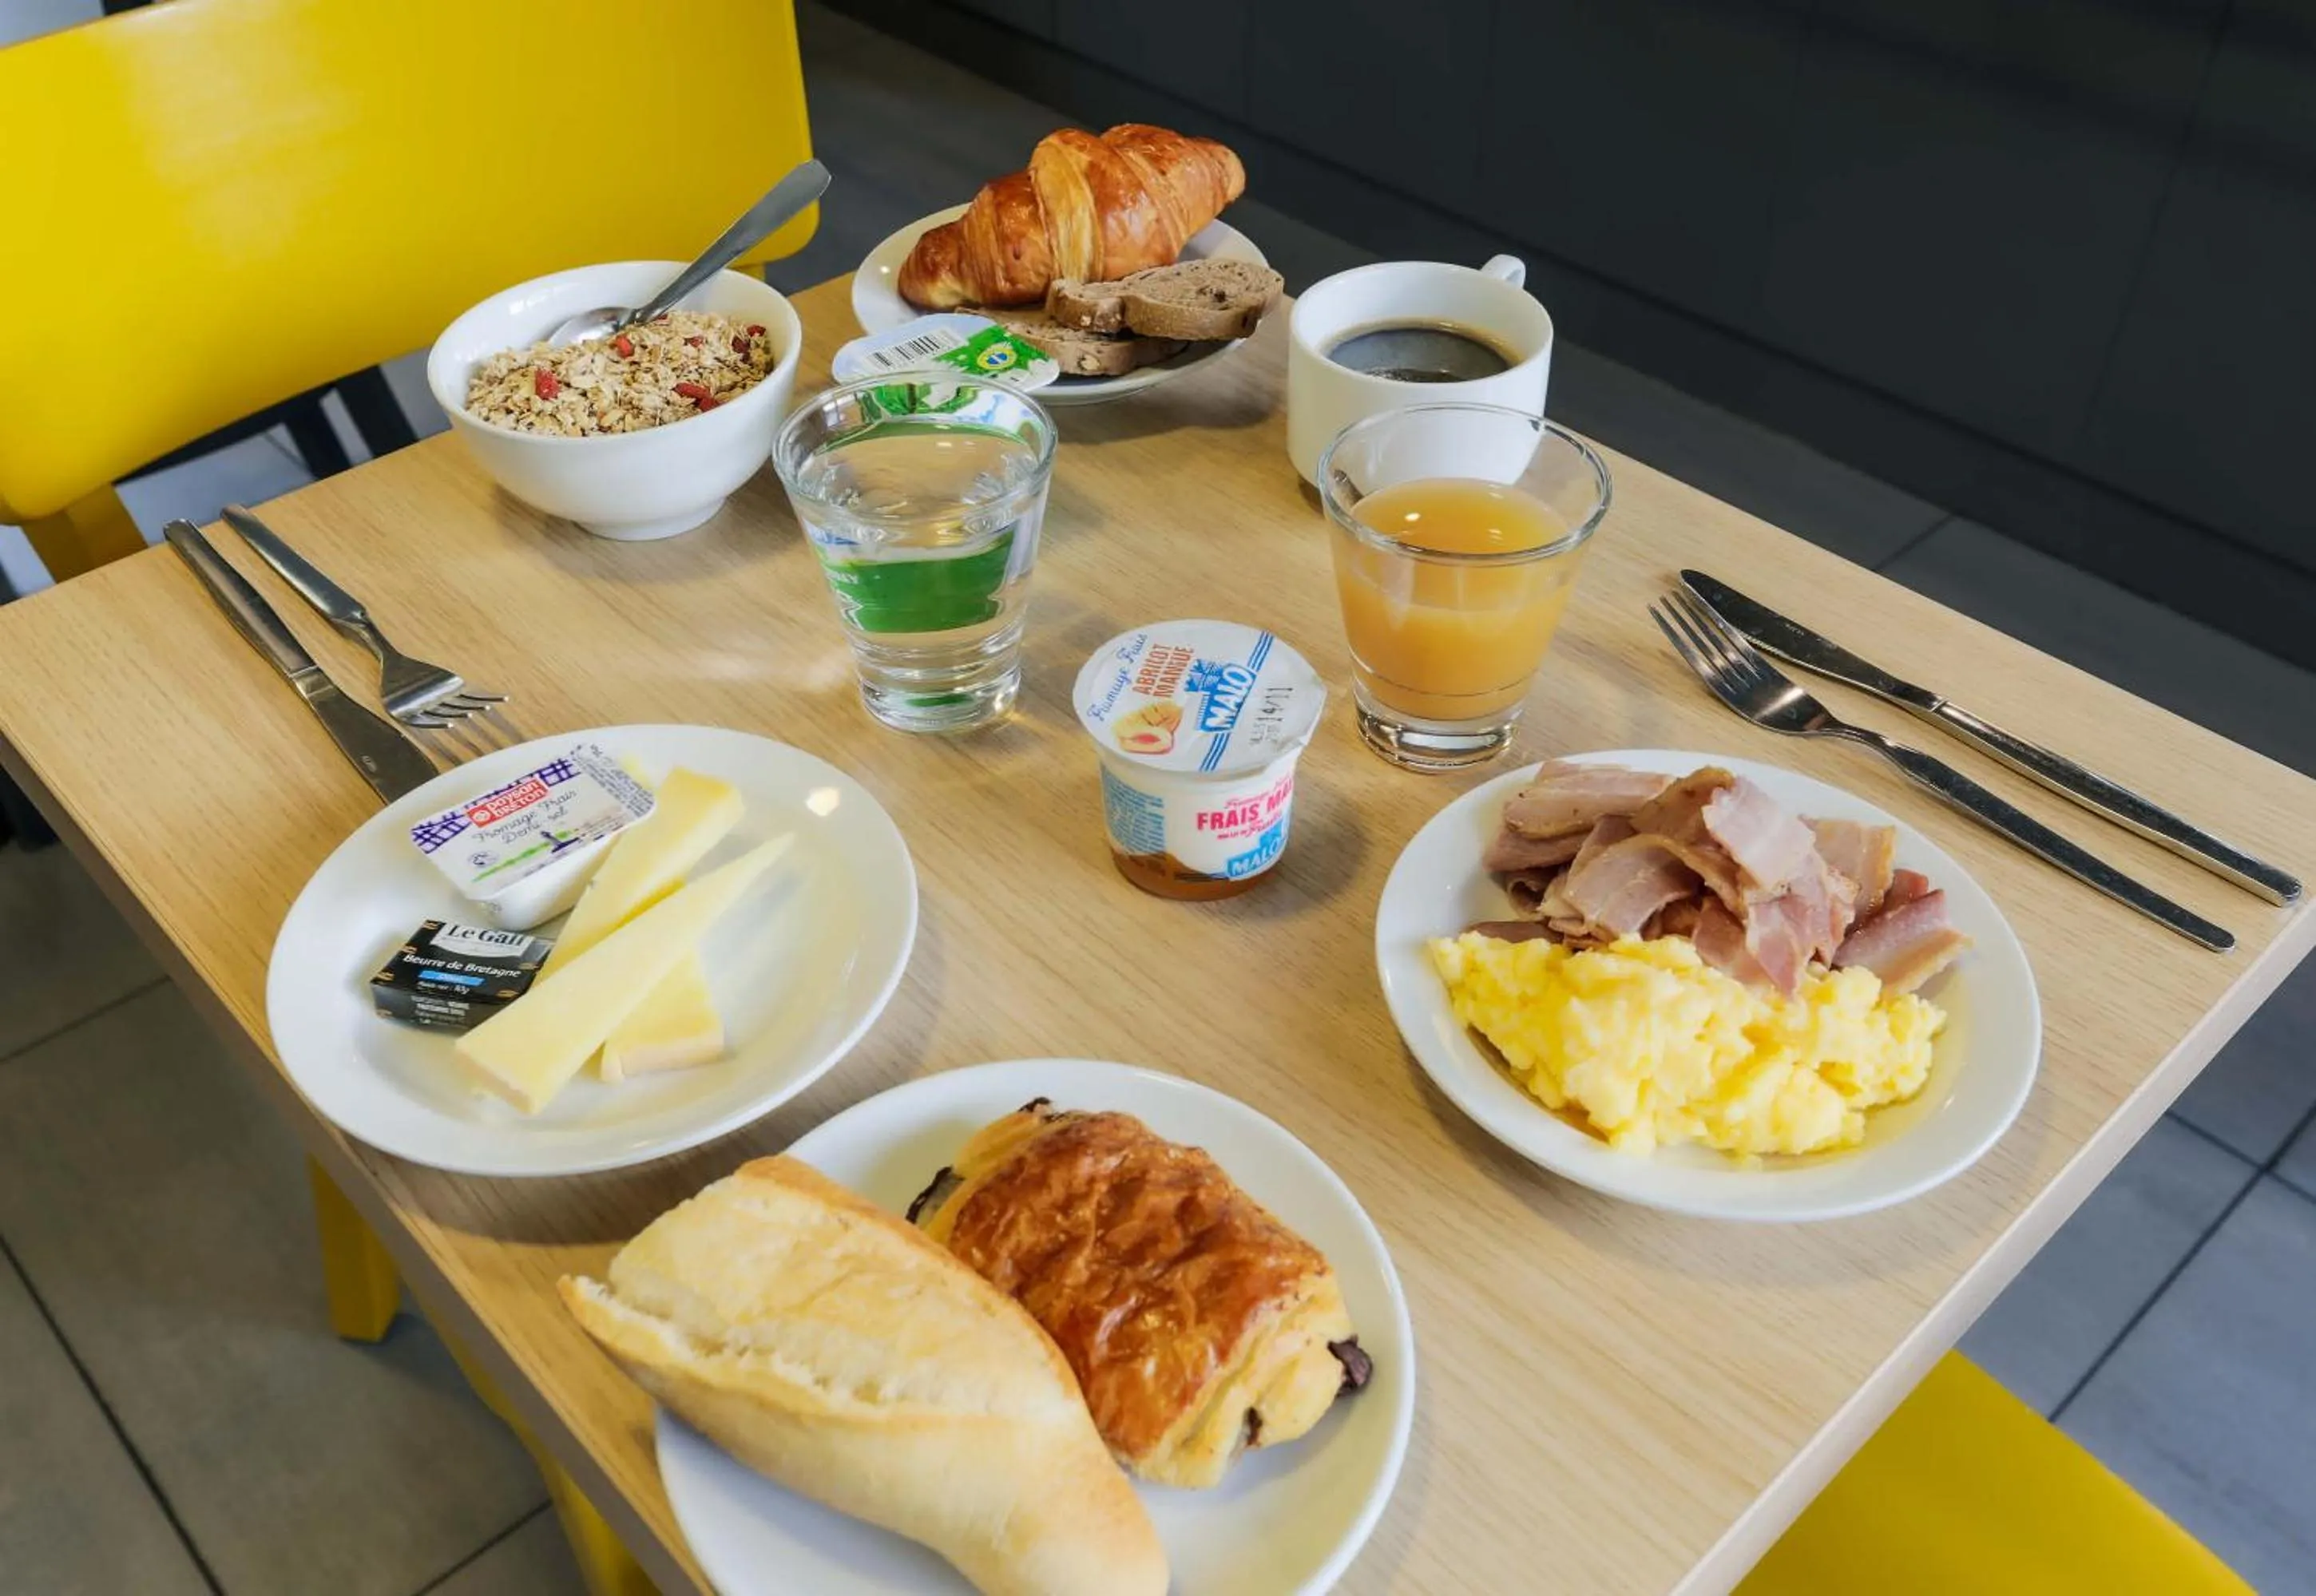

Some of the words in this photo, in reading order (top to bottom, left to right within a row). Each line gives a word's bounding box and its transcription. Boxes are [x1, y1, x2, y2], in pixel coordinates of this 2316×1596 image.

[1205, 667, 1254, 728] MALO
[1196, 802, 1260, 831] FRAIS
[1231, 838, 1282, 876] MALO
[447, 925, 474, 938] Le
[478, 929, 525, 947] Gall
[403, 954, 446, 968] Beurre
[446, 960, 464, 970] de
[465, 962, 522, 979] Bretagne
